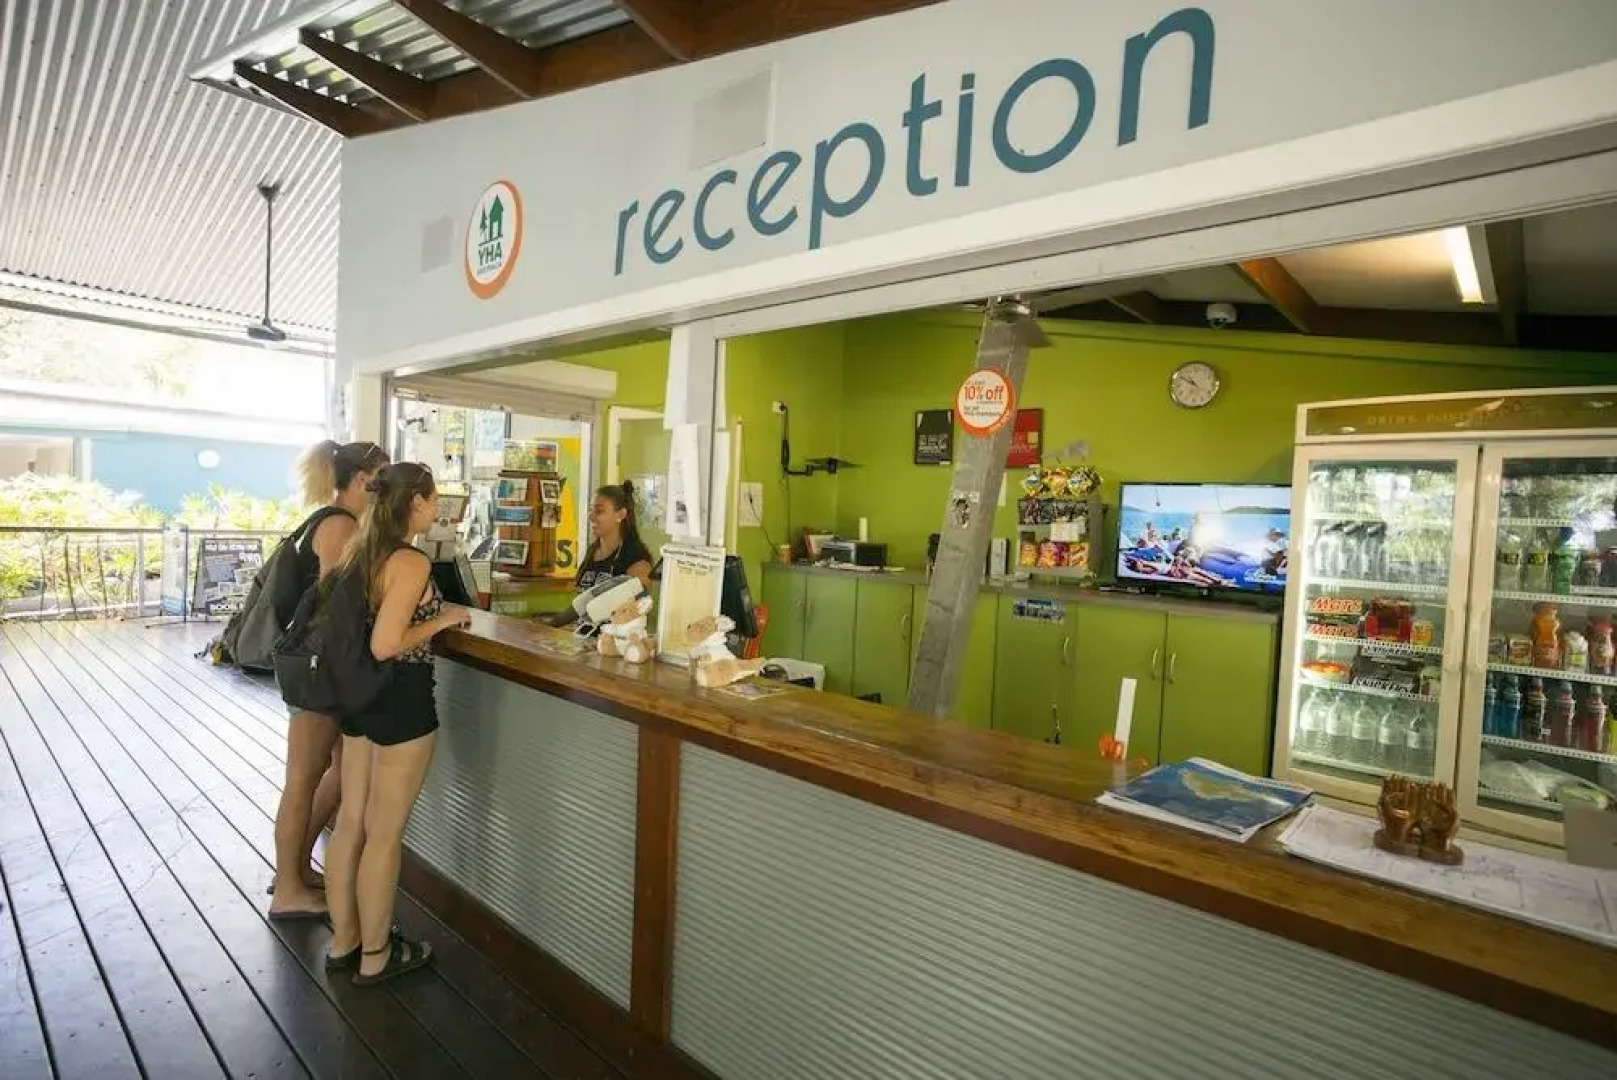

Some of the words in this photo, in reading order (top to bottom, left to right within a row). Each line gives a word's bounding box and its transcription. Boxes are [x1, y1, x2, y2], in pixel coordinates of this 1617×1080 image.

[614, 7, 1215, 275] reception
[478, 242, 502, 266] YHA
[964, 386, 984, 400] 10%
[986, 385, 1004, 400] off
[556, 539, 573, 568] S
